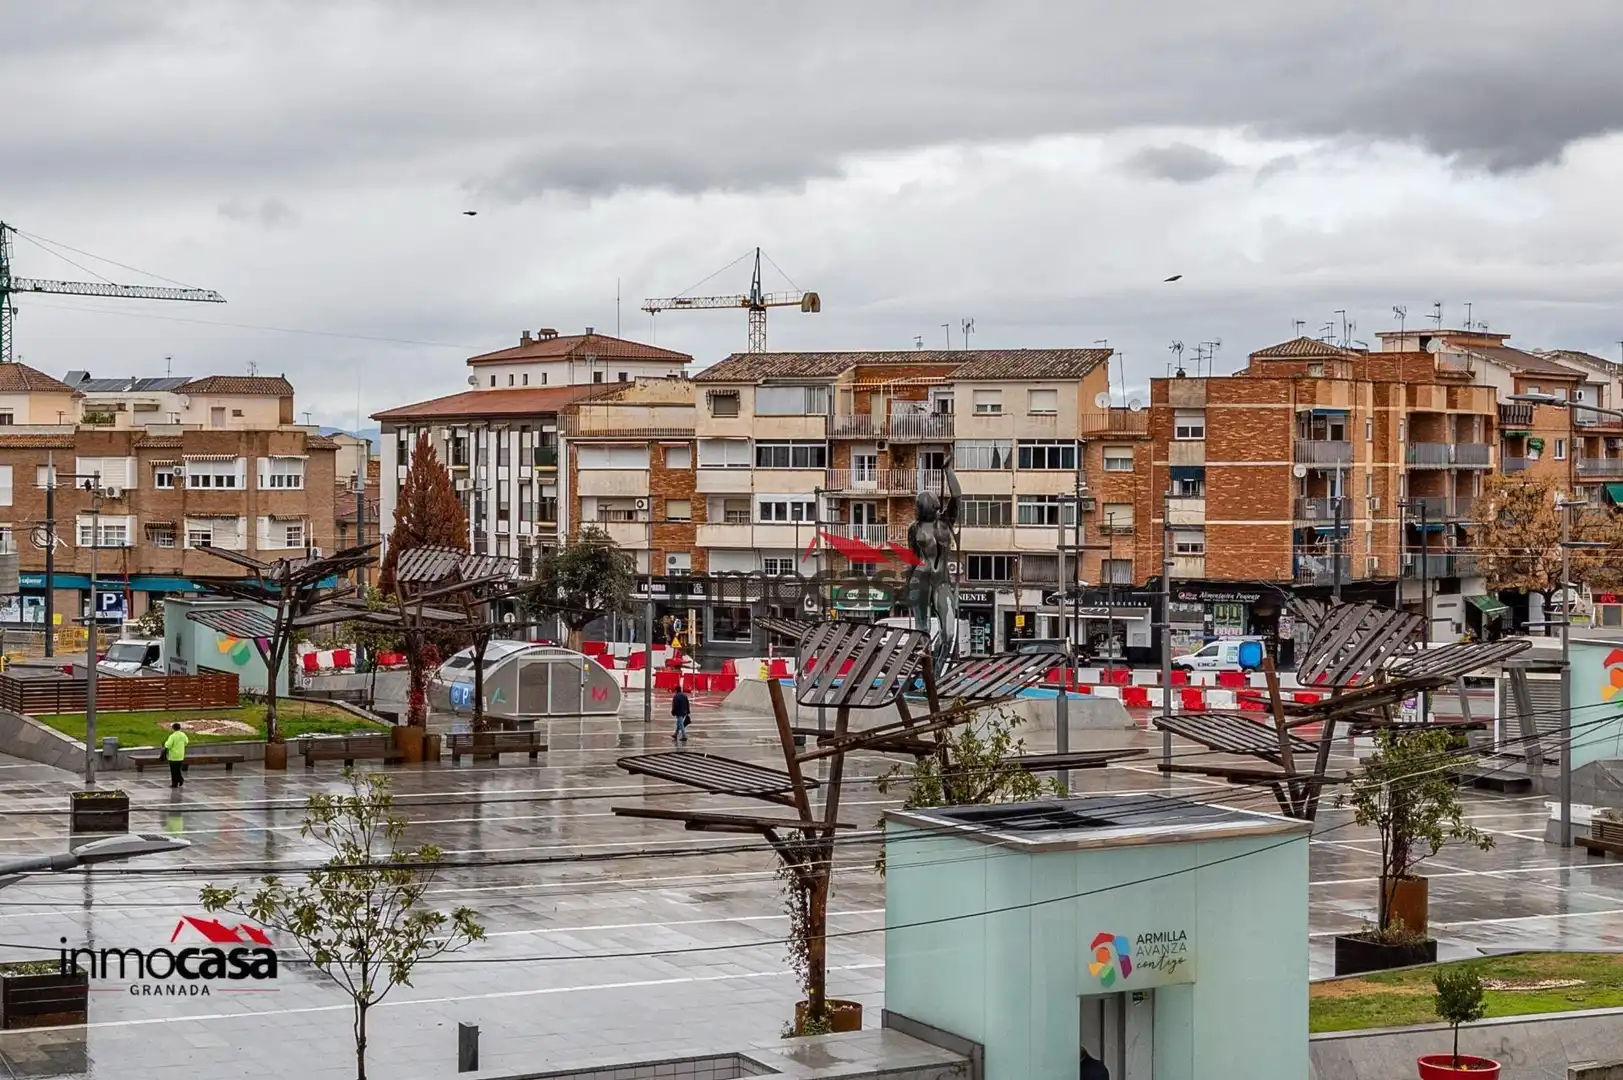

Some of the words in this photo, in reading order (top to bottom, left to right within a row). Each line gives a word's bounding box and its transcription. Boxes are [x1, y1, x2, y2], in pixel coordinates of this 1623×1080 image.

[102, 593, 116, 610] P
[1135, 930, 1188, 944] ARMILLA
[1135, 942, 1188, 957] AVANZA
[1135, 952, 1187, 974] contigo
